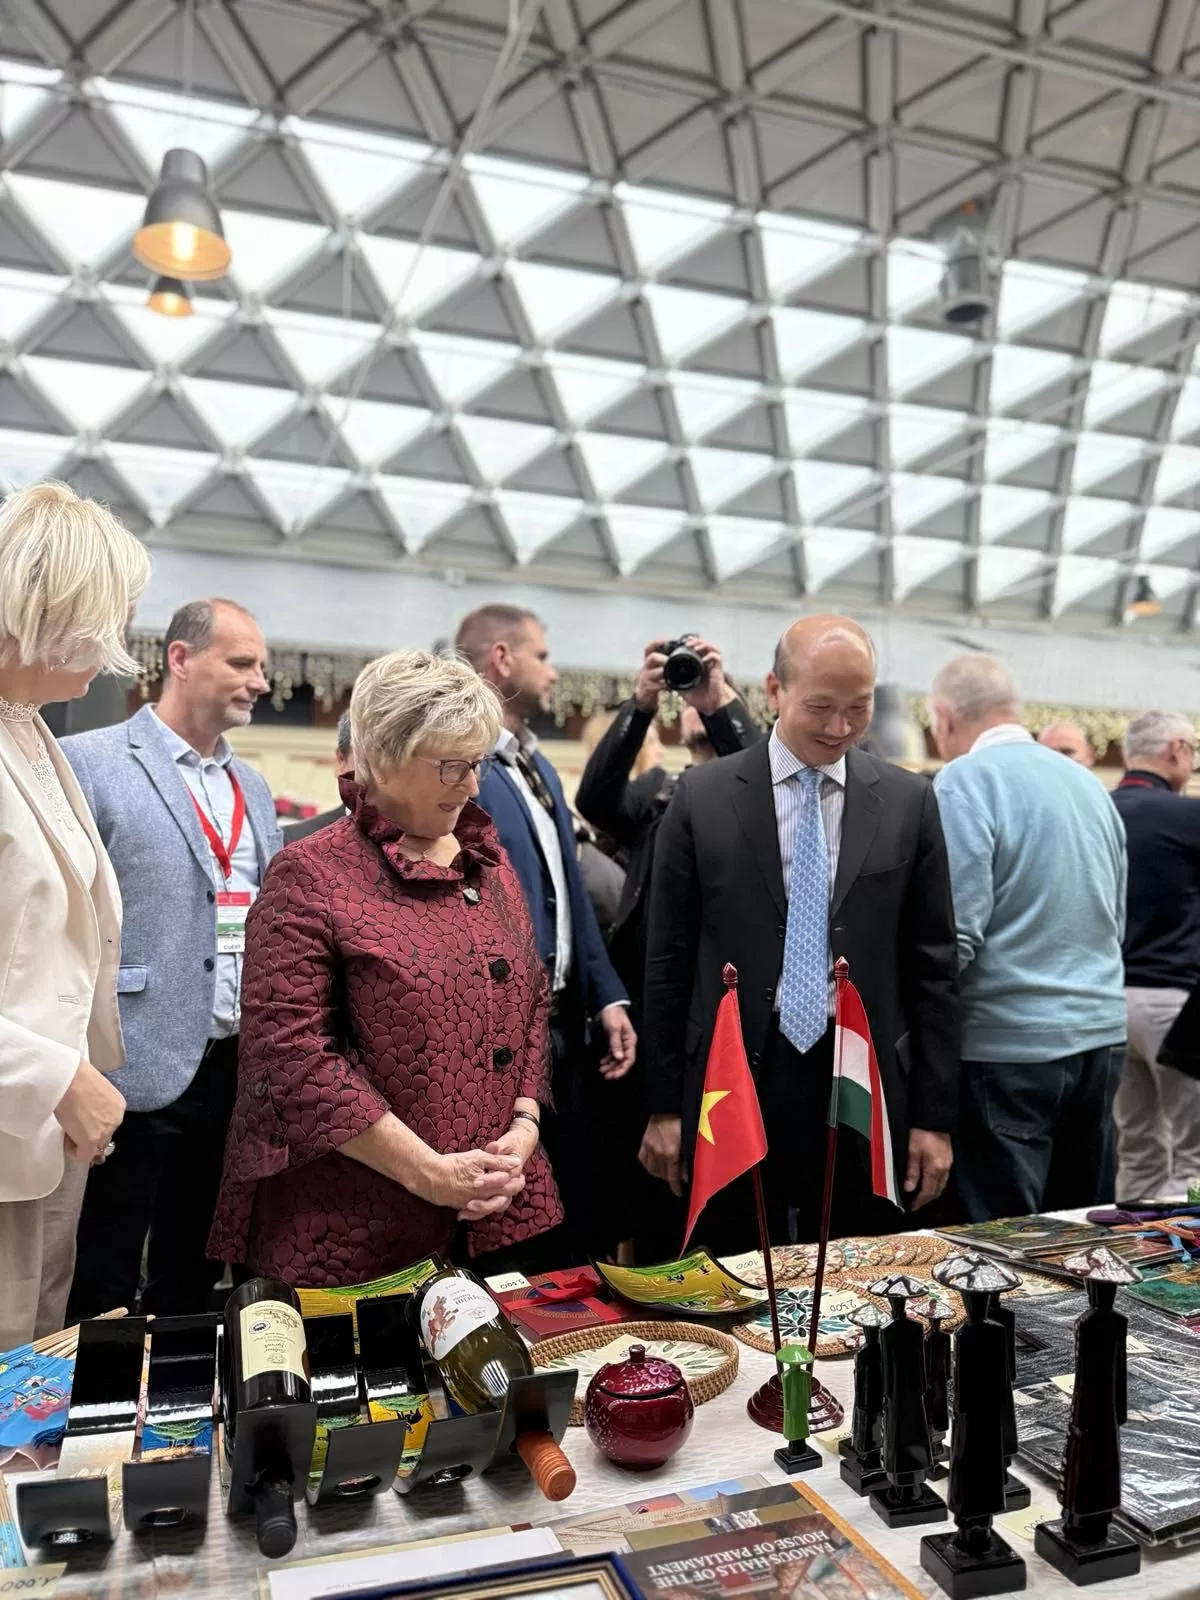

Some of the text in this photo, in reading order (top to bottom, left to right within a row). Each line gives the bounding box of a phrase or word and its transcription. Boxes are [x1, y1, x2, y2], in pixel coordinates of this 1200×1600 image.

[829, 1299, 857, 1312] 2500
[753, 1542, 775, 1555] OF
[774, 1530, 831, 1549] HOUSE
[647, 1545, 753, 1577] PARLIAMENT
[652, 1542, 836, 1589] FAMOUS HALLS OF THE
